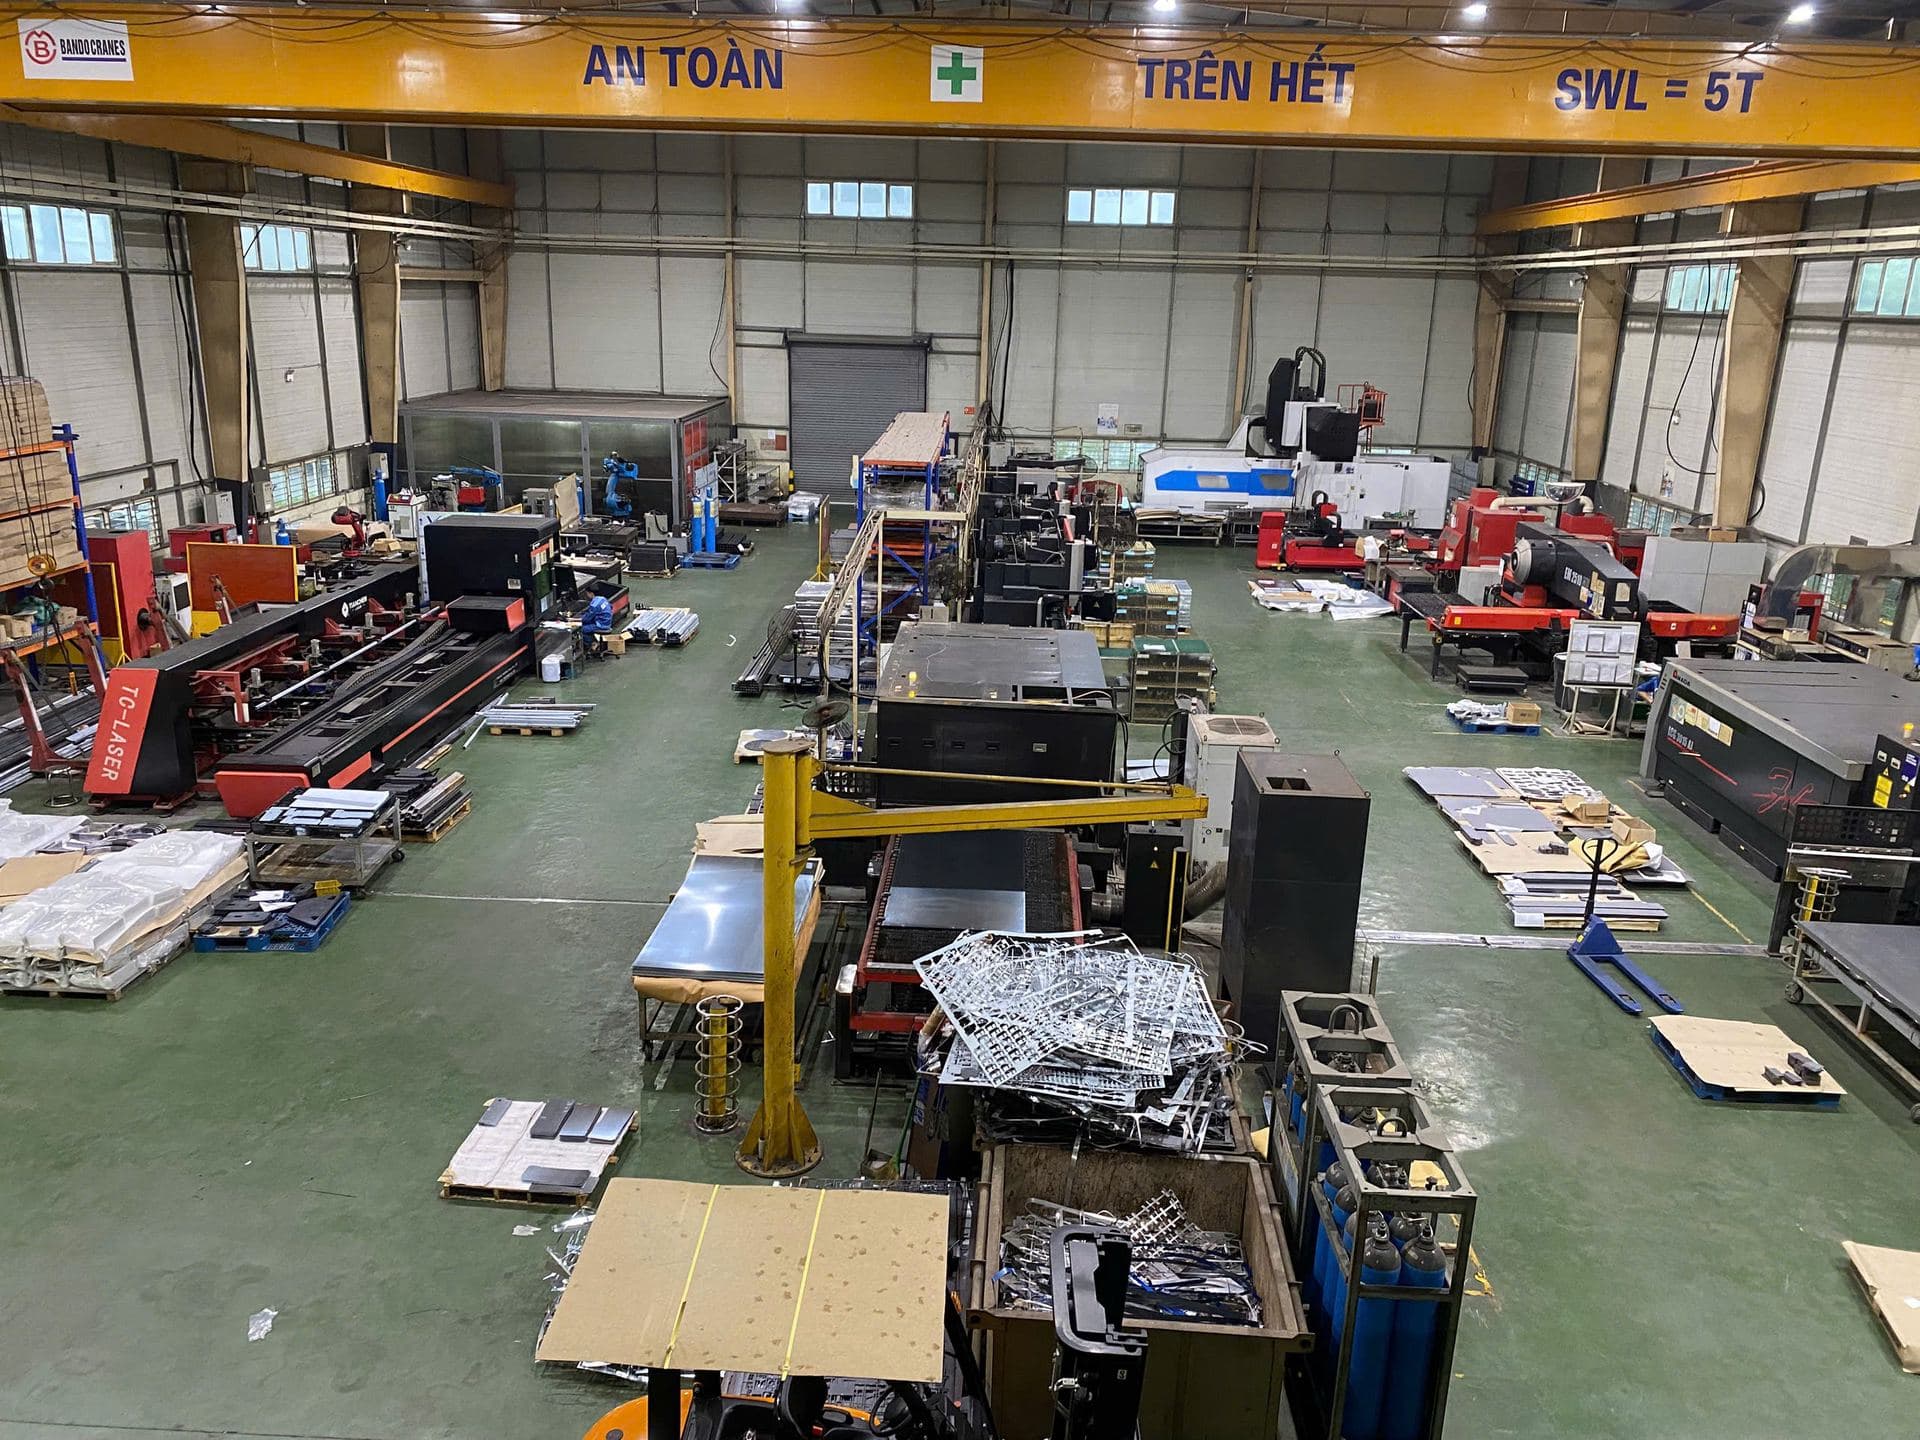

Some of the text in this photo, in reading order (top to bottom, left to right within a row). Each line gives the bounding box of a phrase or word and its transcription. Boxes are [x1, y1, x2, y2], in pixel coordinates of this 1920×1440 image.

[583, 37, 783, 89] AN TOÀN
[1137, 43, 1356, 103] TRÊN HẾT
[1554, 68, 1764, 113] SWL = 5T
[101, 685, 139, 782] TC-LASER
